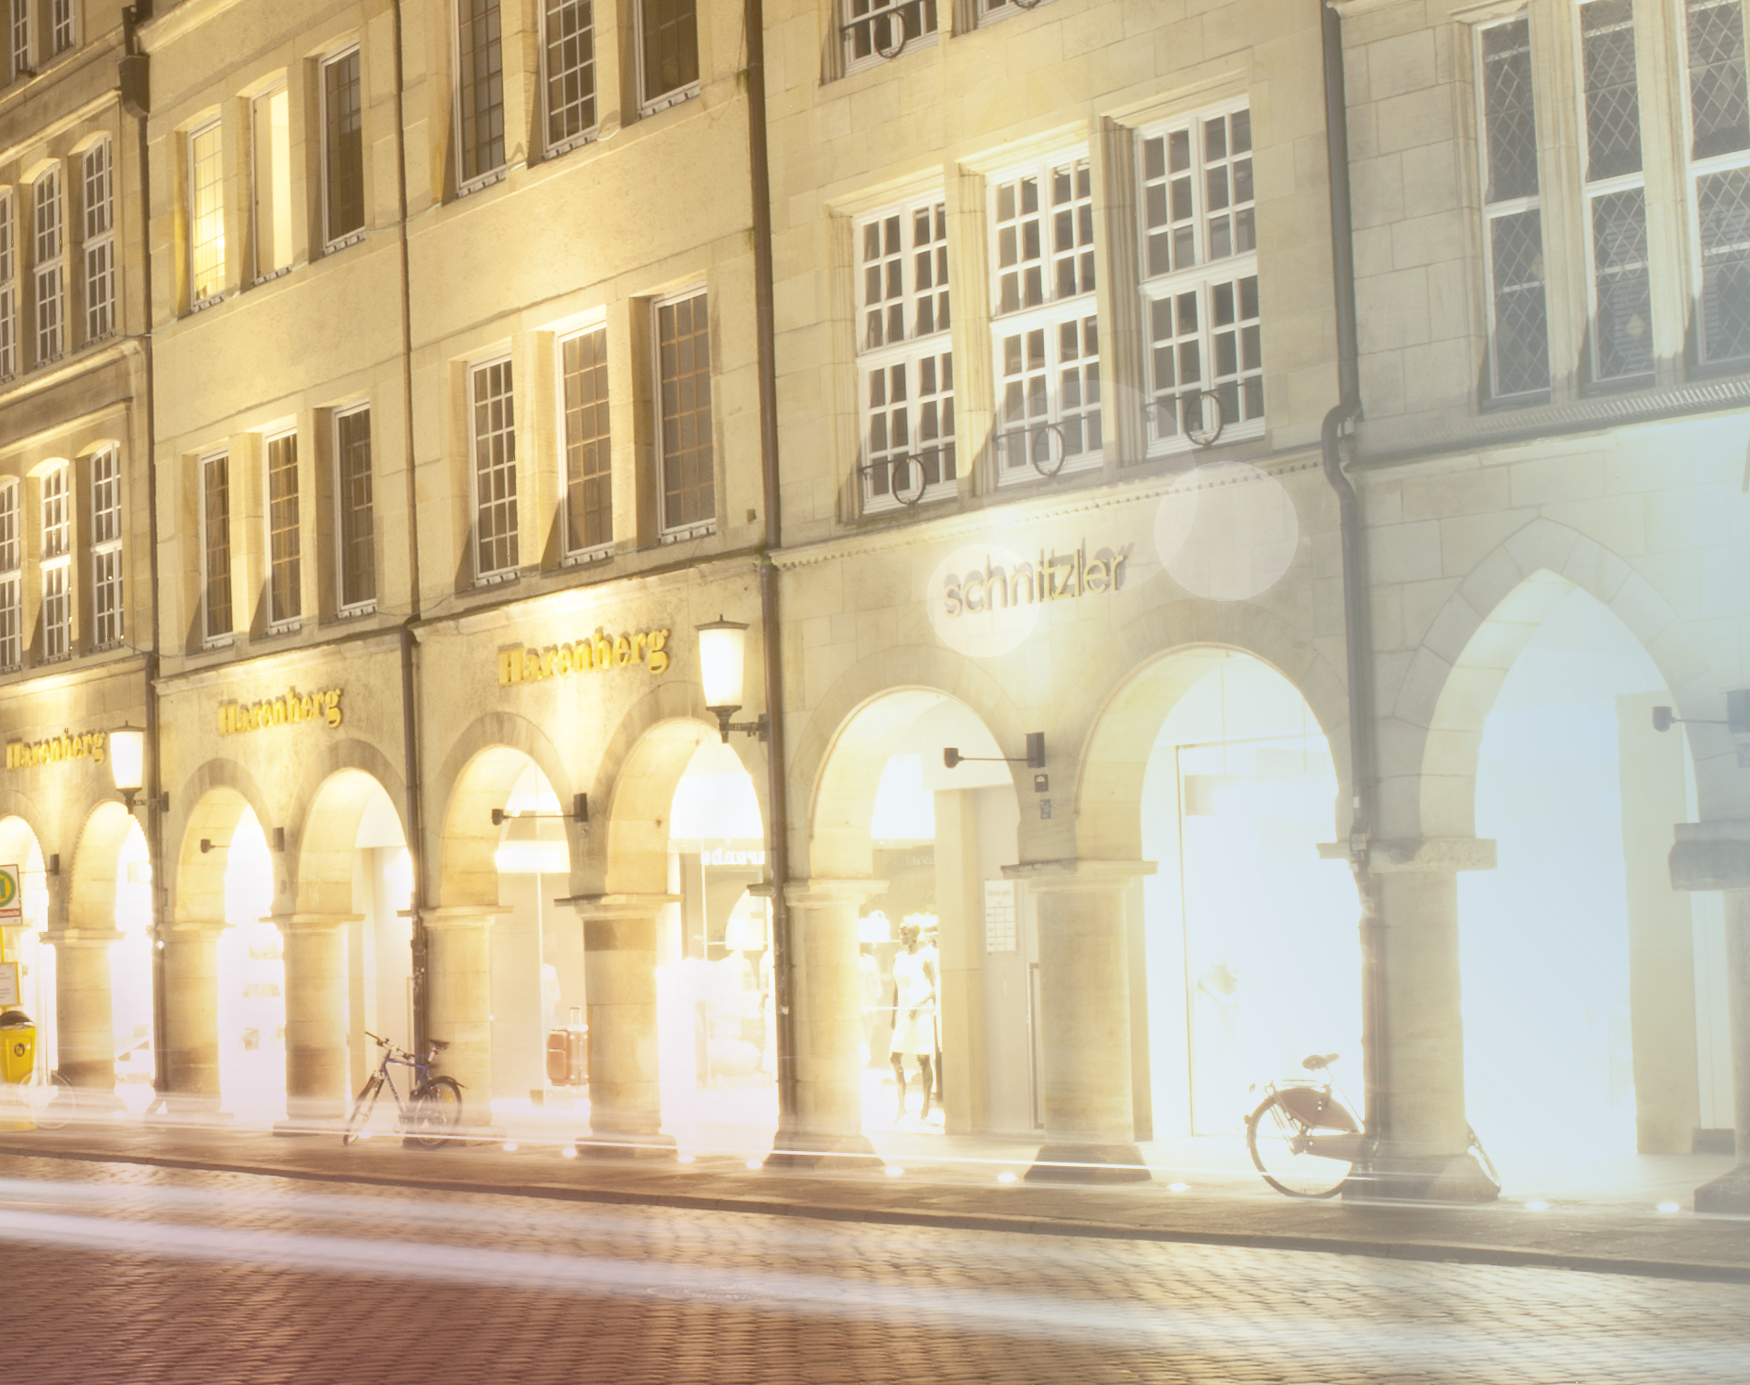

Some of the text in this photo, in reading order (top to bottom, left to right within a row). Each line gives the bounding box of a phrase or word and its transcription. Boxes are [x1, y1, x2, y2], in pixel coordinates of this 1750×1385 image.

[944, 545, 1127, 616] schnitzler
[498, 628, 671, 686] Harenberg
[218, 688, 342, 735] Harenberg
[6, 731, 105, 770] Harenberg
